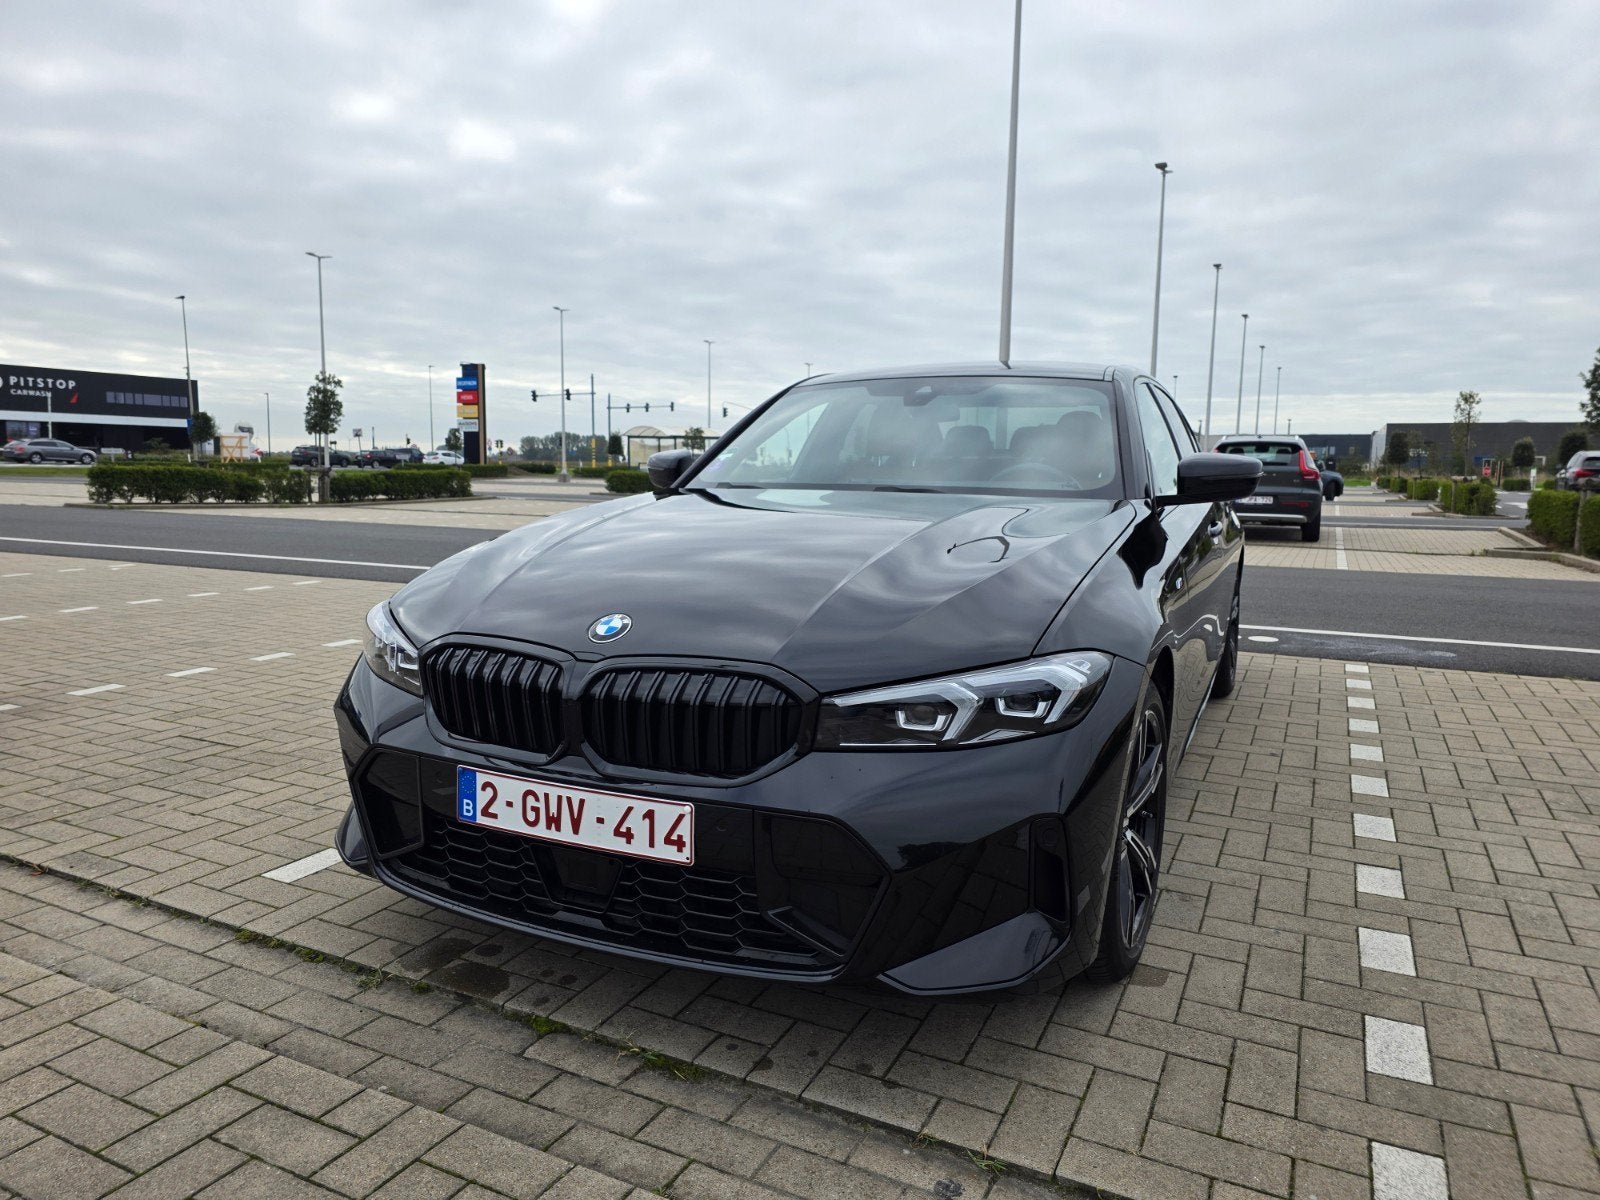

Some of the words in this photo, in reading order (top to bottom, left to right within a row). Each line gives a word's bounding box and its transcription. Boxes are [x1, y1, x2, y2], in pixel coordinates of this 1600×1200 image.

[9, 376, 76, 389] PITSTOP
[10, 389, 52, 397] CARWASH
[463, 799, 473, 817] B
[480, 781, 686, 853] 2-GWV-414
